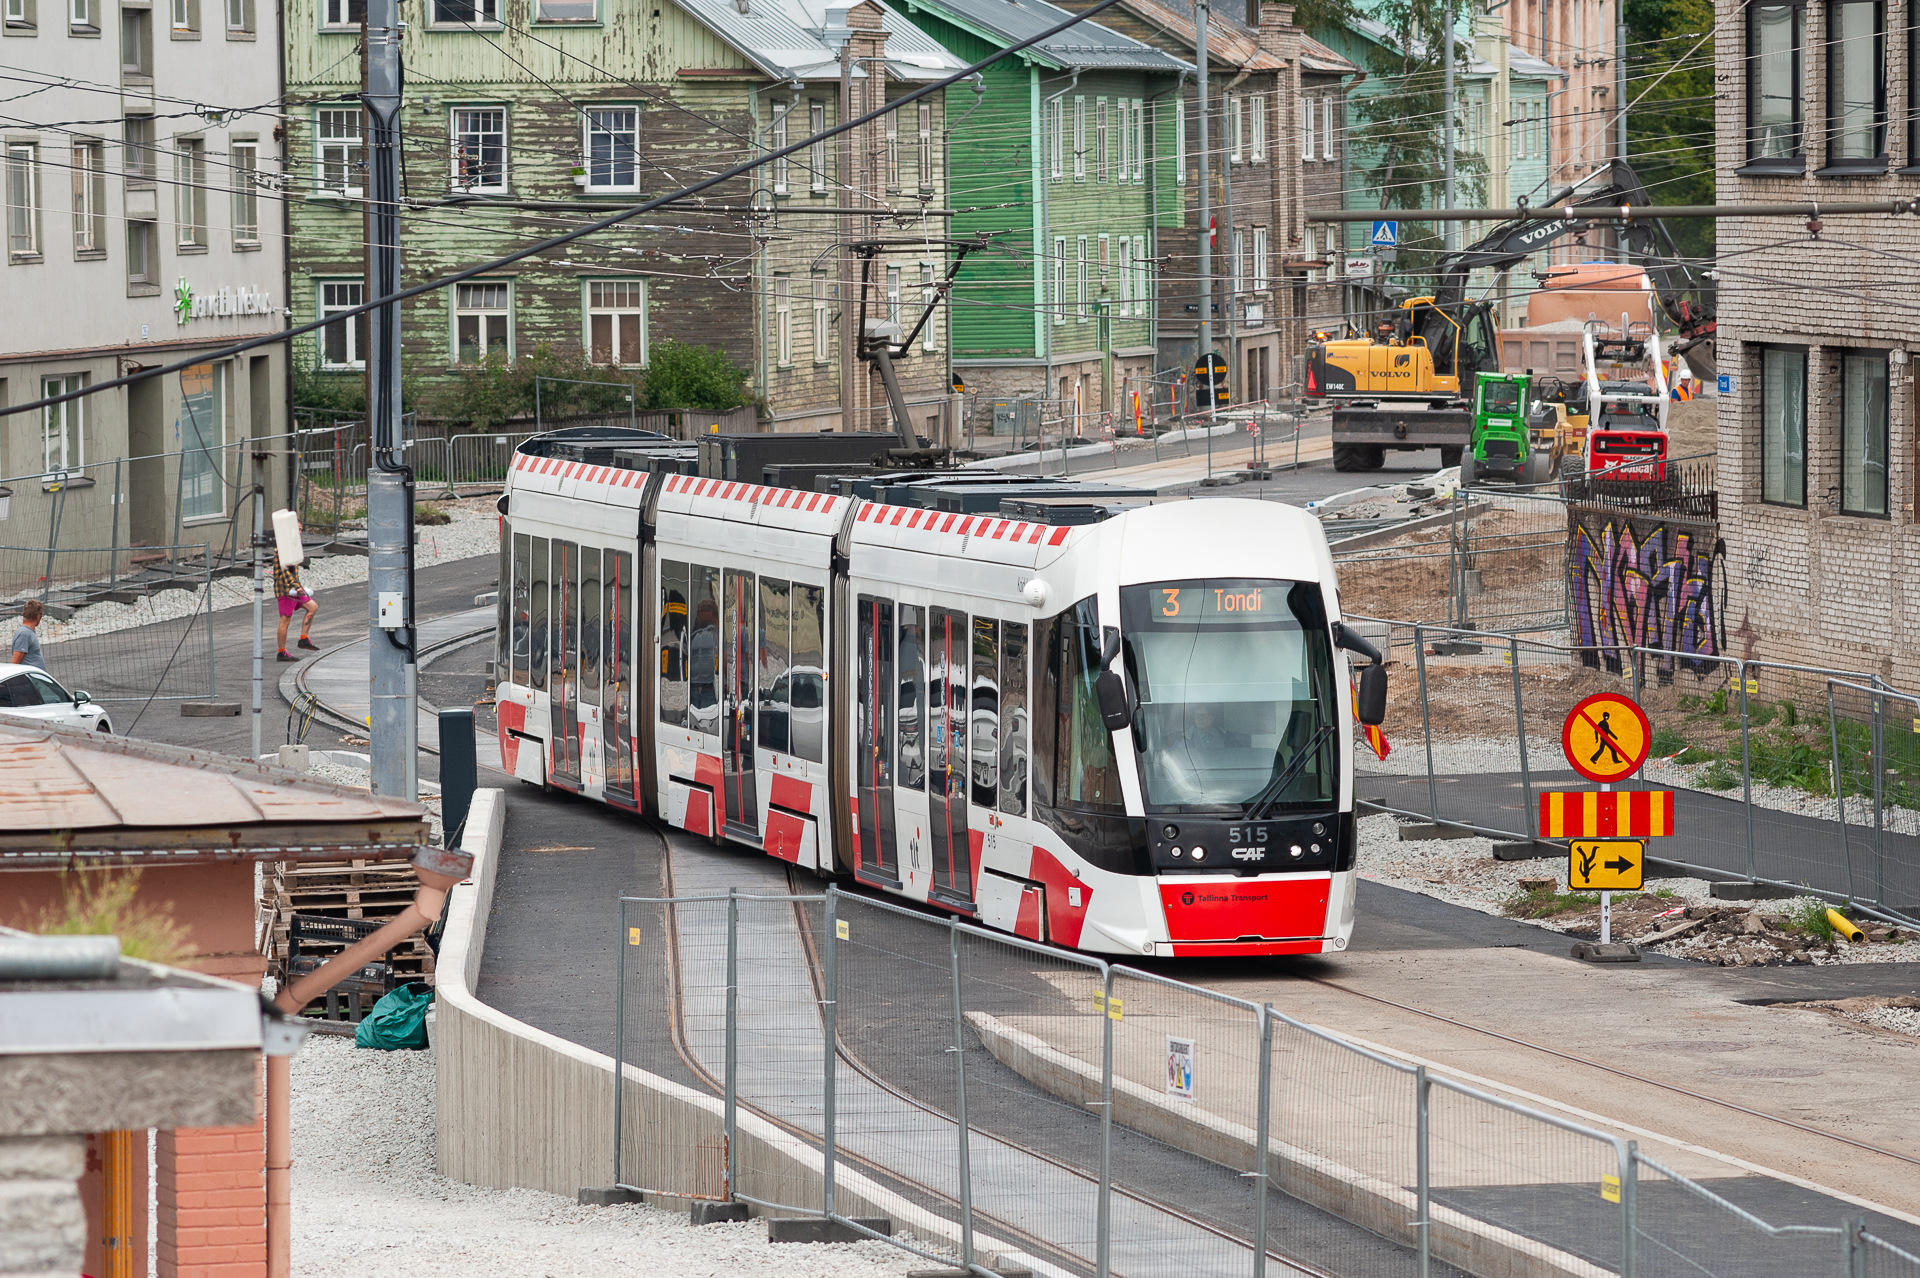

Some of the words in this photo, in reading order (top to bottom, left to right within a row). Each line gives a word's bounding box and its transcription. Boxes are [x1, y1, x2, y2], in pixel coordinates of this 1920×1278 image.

[1519, 219, 1577, 244] VOLV
[1162, 588, 1180, 617] 3
[1214, 588, 1262, 612] Tondi
[987, 833, 997, 850] 515
[1229, 826, 1269, 843] 515
[1231, 847, 1266, 861] CAF
[1197, 894, 1229, 902] Tallinna
[1230, 893, 1269, 903] Transport
